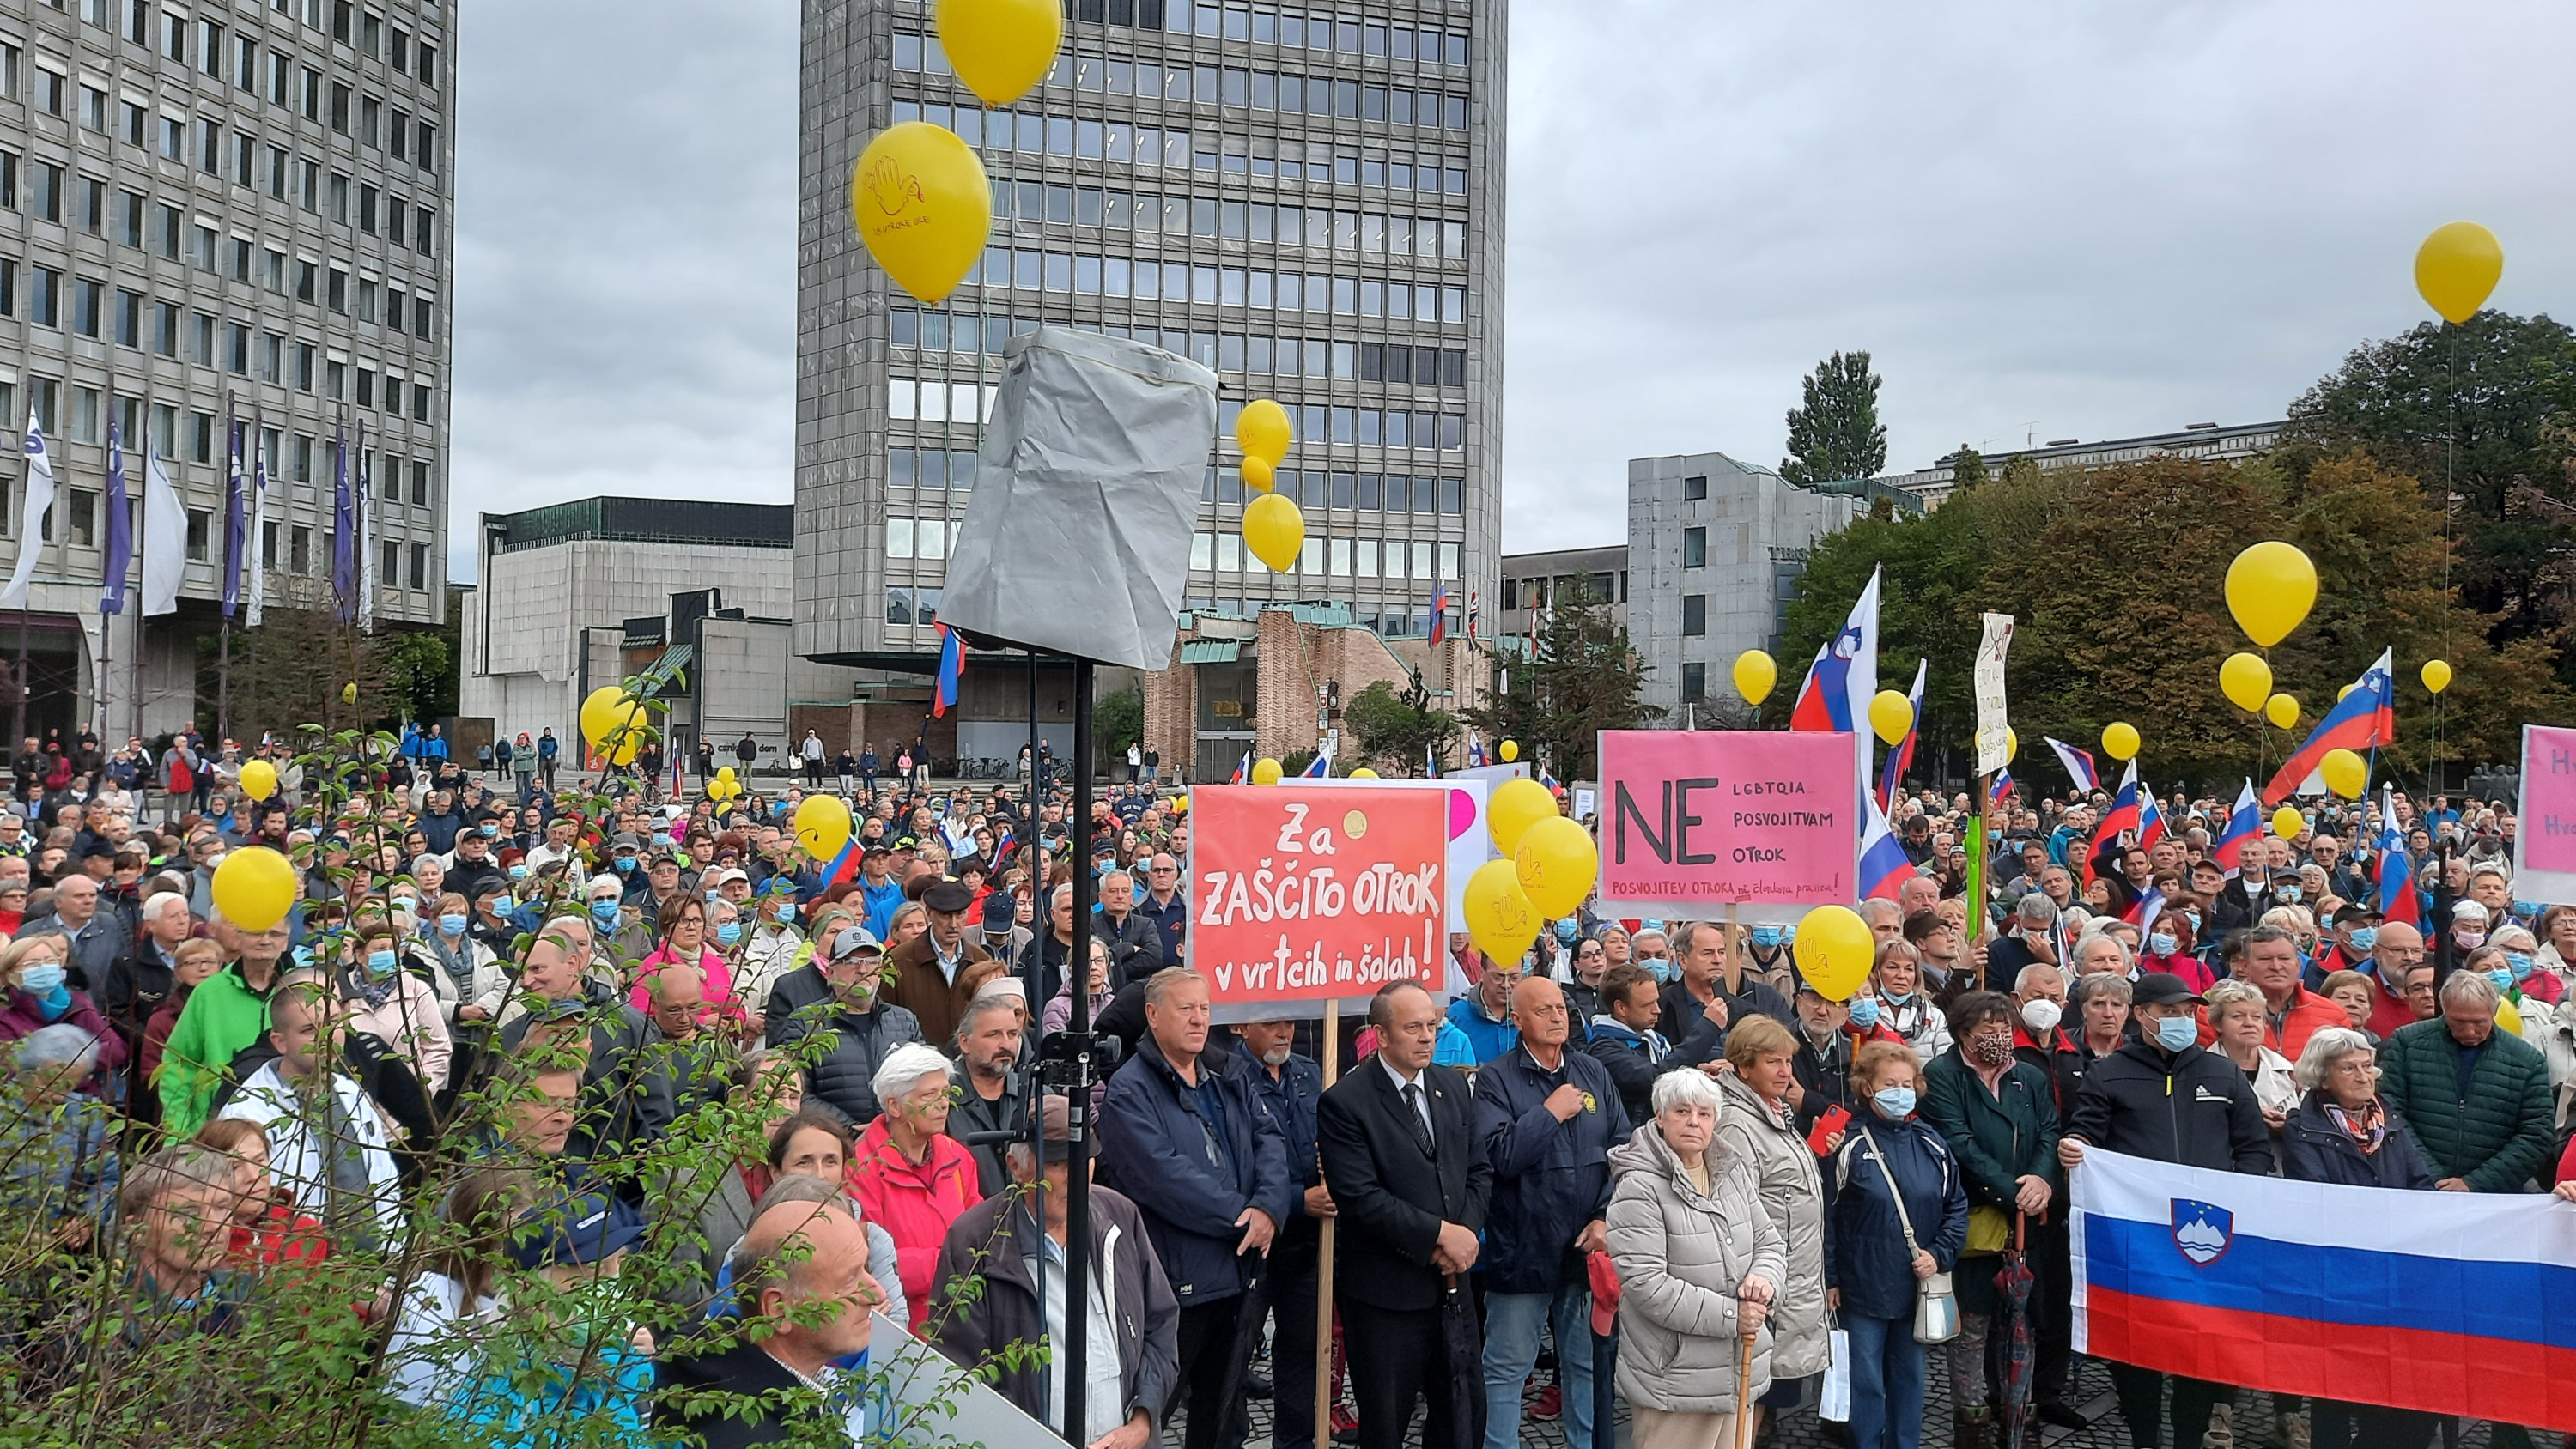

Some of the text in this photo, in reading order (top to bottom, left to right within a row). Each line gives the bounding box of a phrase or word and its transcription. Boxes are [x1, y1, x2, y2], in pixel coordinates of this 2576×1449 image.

[758, 743, 777, 753] dom
[1276, 802, 1337, 856] Za
[1615, 778, 1719, 865] NE
[1734, 811, 1833, 828] POSVOJITVAM
[1732, 846, 1787, 863] OTROK
[1200, 858, 1441, 927] ZAŠČITO OTROK
[1612, 880, 1687, 895] POSVOJITEV
[1692, 881, 1735, 894] OTROKA
[1737, 884, 1751, 895] ni
[1214, 961, 1234, 992] v
[1241, 932, 1328, 991] vrtcih
[1334, 951, 1352, 983] in
